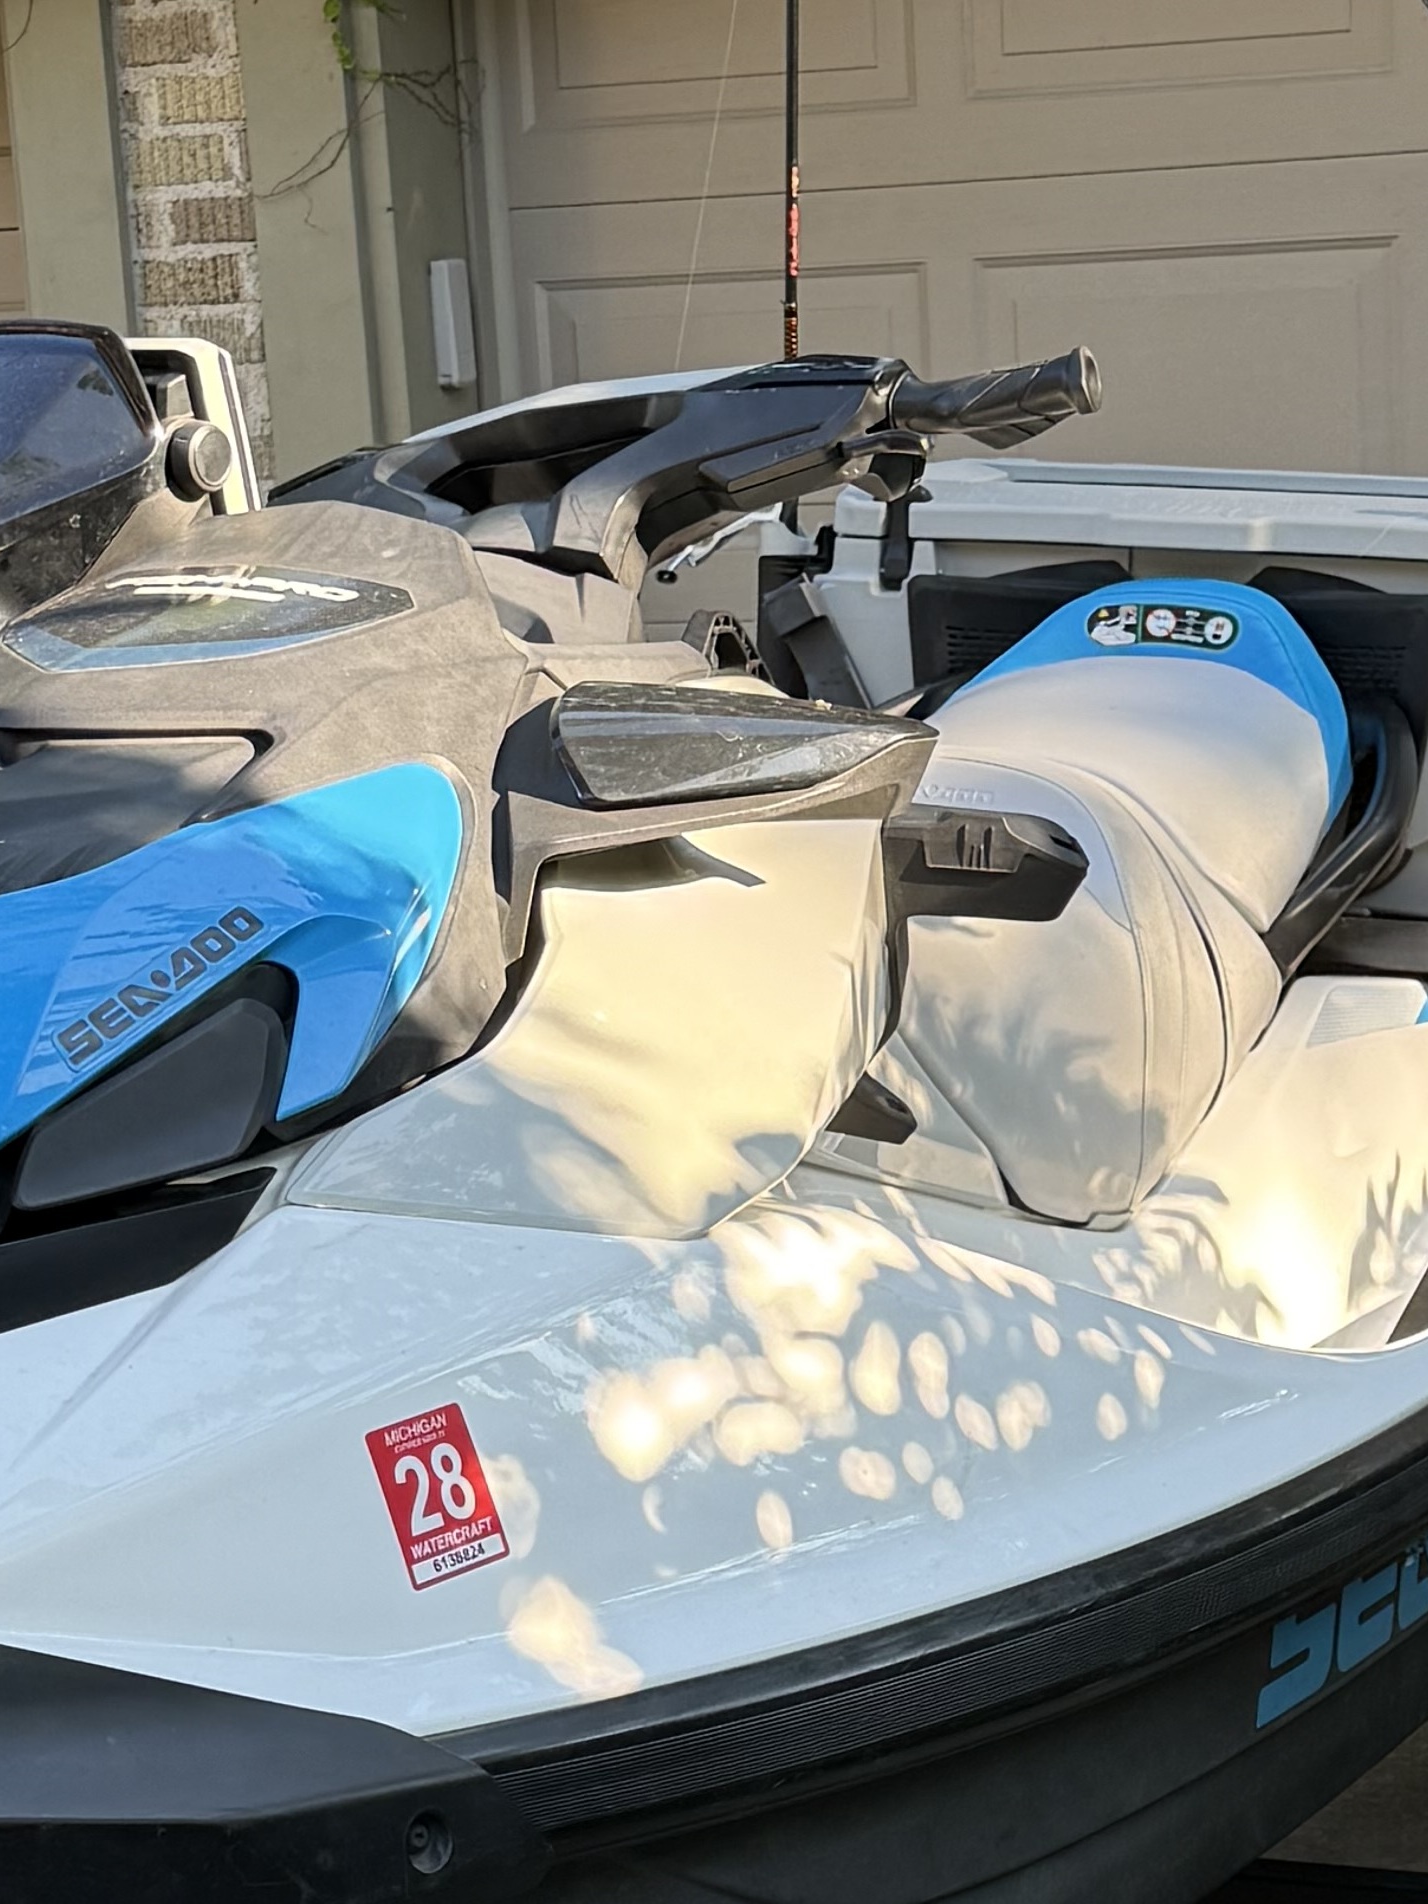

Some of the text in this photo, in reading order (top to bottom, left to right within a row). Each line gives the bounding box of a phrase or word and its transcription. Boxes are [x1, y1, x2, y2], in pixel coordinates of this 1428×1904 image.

[383, 1412, 448, 1447] MICHIGAN
[393, 1442, 477, 1537] 28
[409, 1516, 493, 1560] WATERCRAFT
